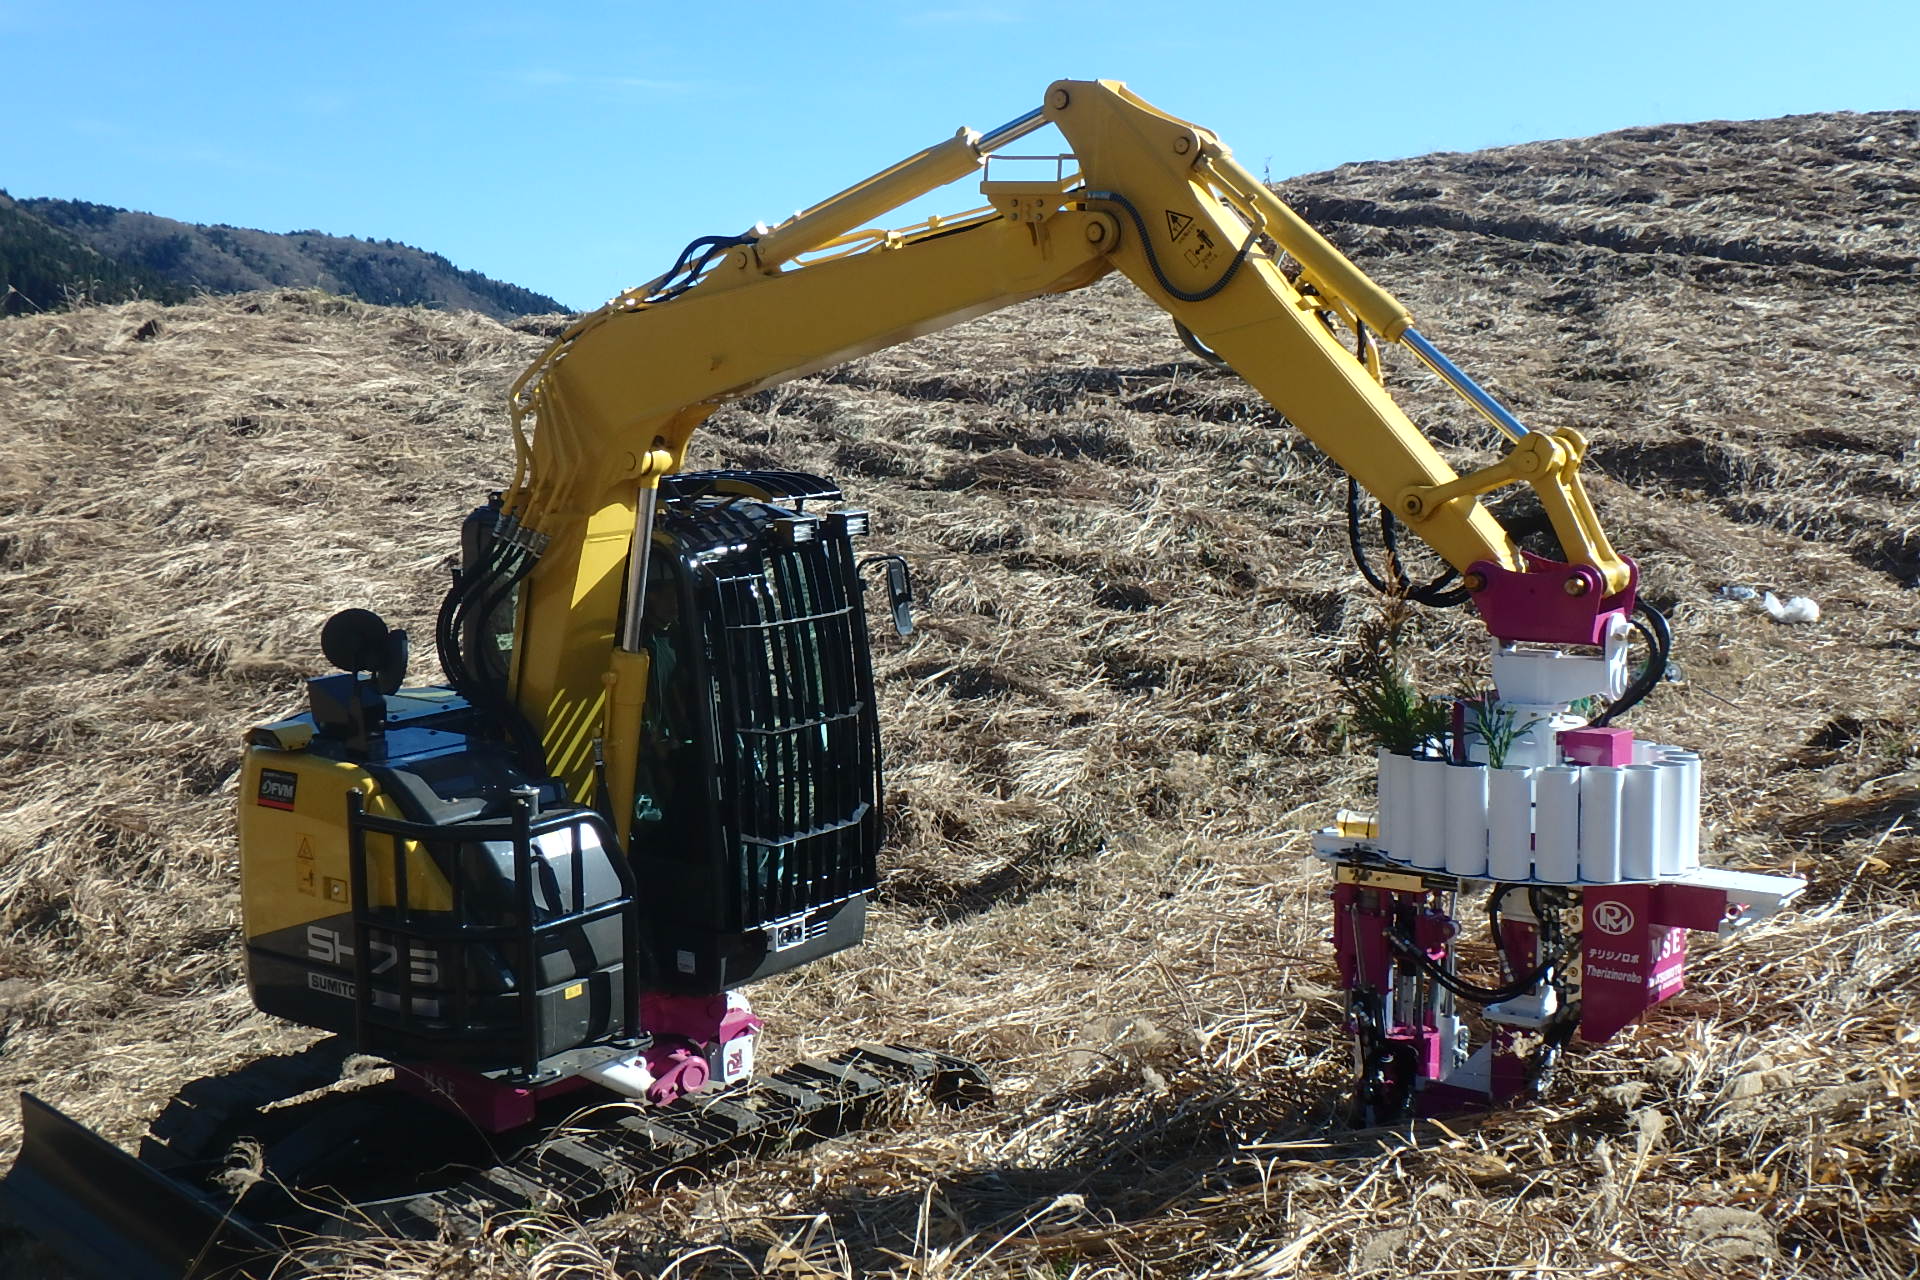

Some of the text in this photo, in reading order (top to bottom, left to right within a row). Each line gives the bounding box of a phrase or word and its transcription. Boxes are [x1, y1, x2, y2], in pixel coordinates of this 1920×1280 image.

[1588, 948, 1640, 964] テリジノロボ
[1585, 964, 1643, 984] Therizinorobo
